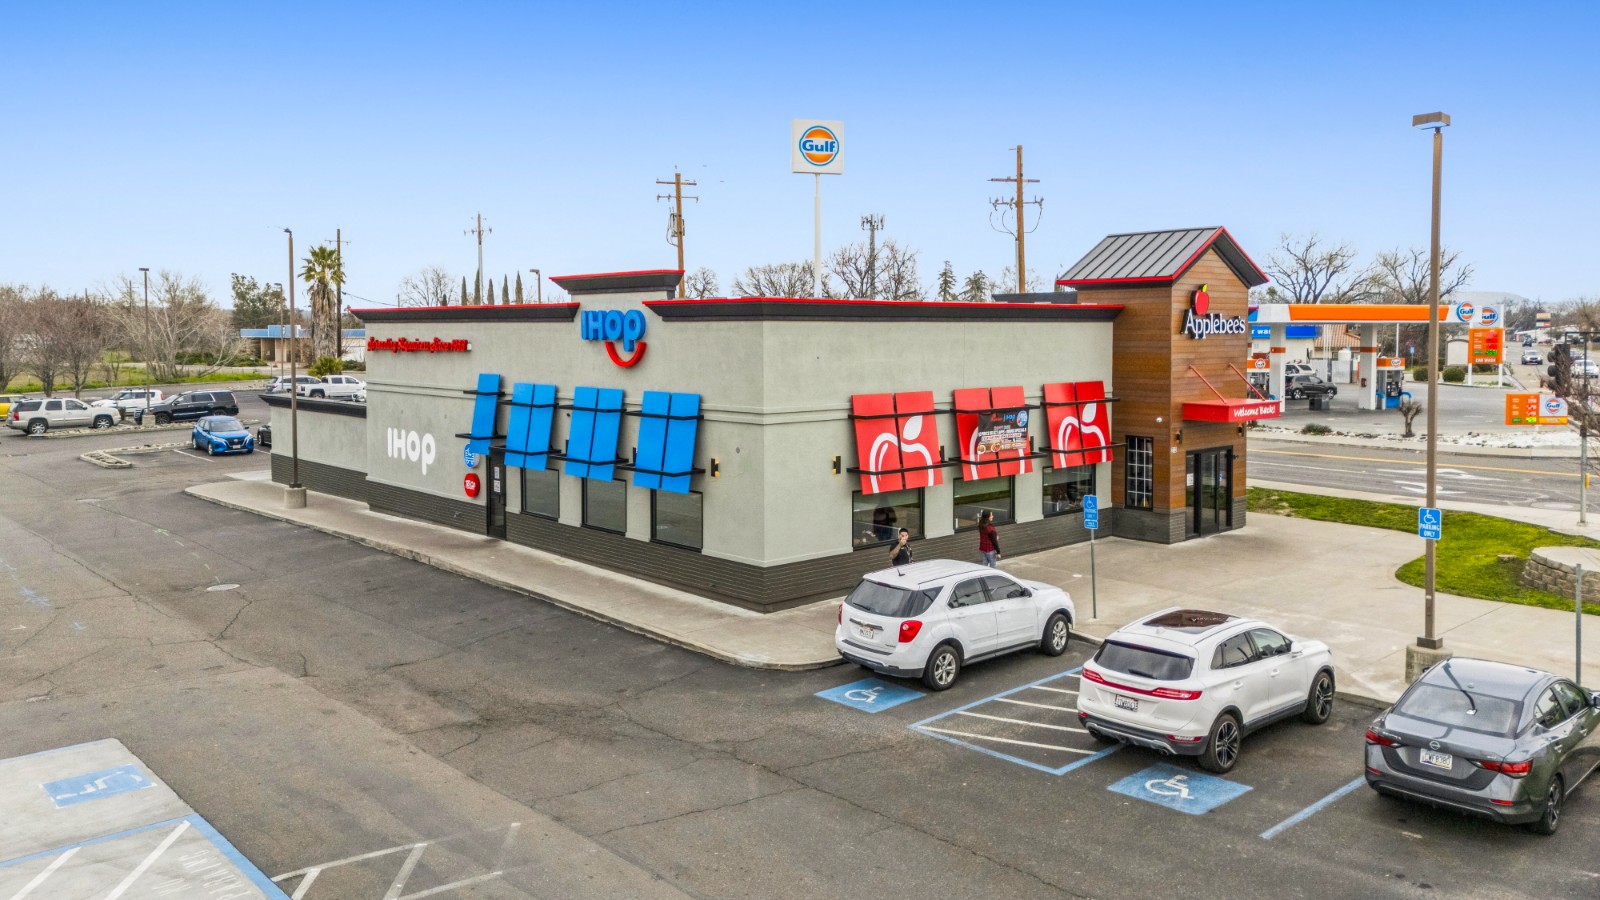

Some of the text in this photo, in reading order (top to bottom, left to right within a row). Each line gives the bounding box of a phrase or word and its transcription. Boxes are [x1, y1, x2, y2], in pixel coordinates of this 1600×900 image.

[802, 139, 836, 153] Gulf
[581, 309, 646, 352] IHOP
[1184, 308, 1246, 339] Applebee's
[1233, 405, 1276, 417] Welcome Back!
[387, 427, 436, 476] IHOP
[1419, 523, 1441, 531] PARKING
